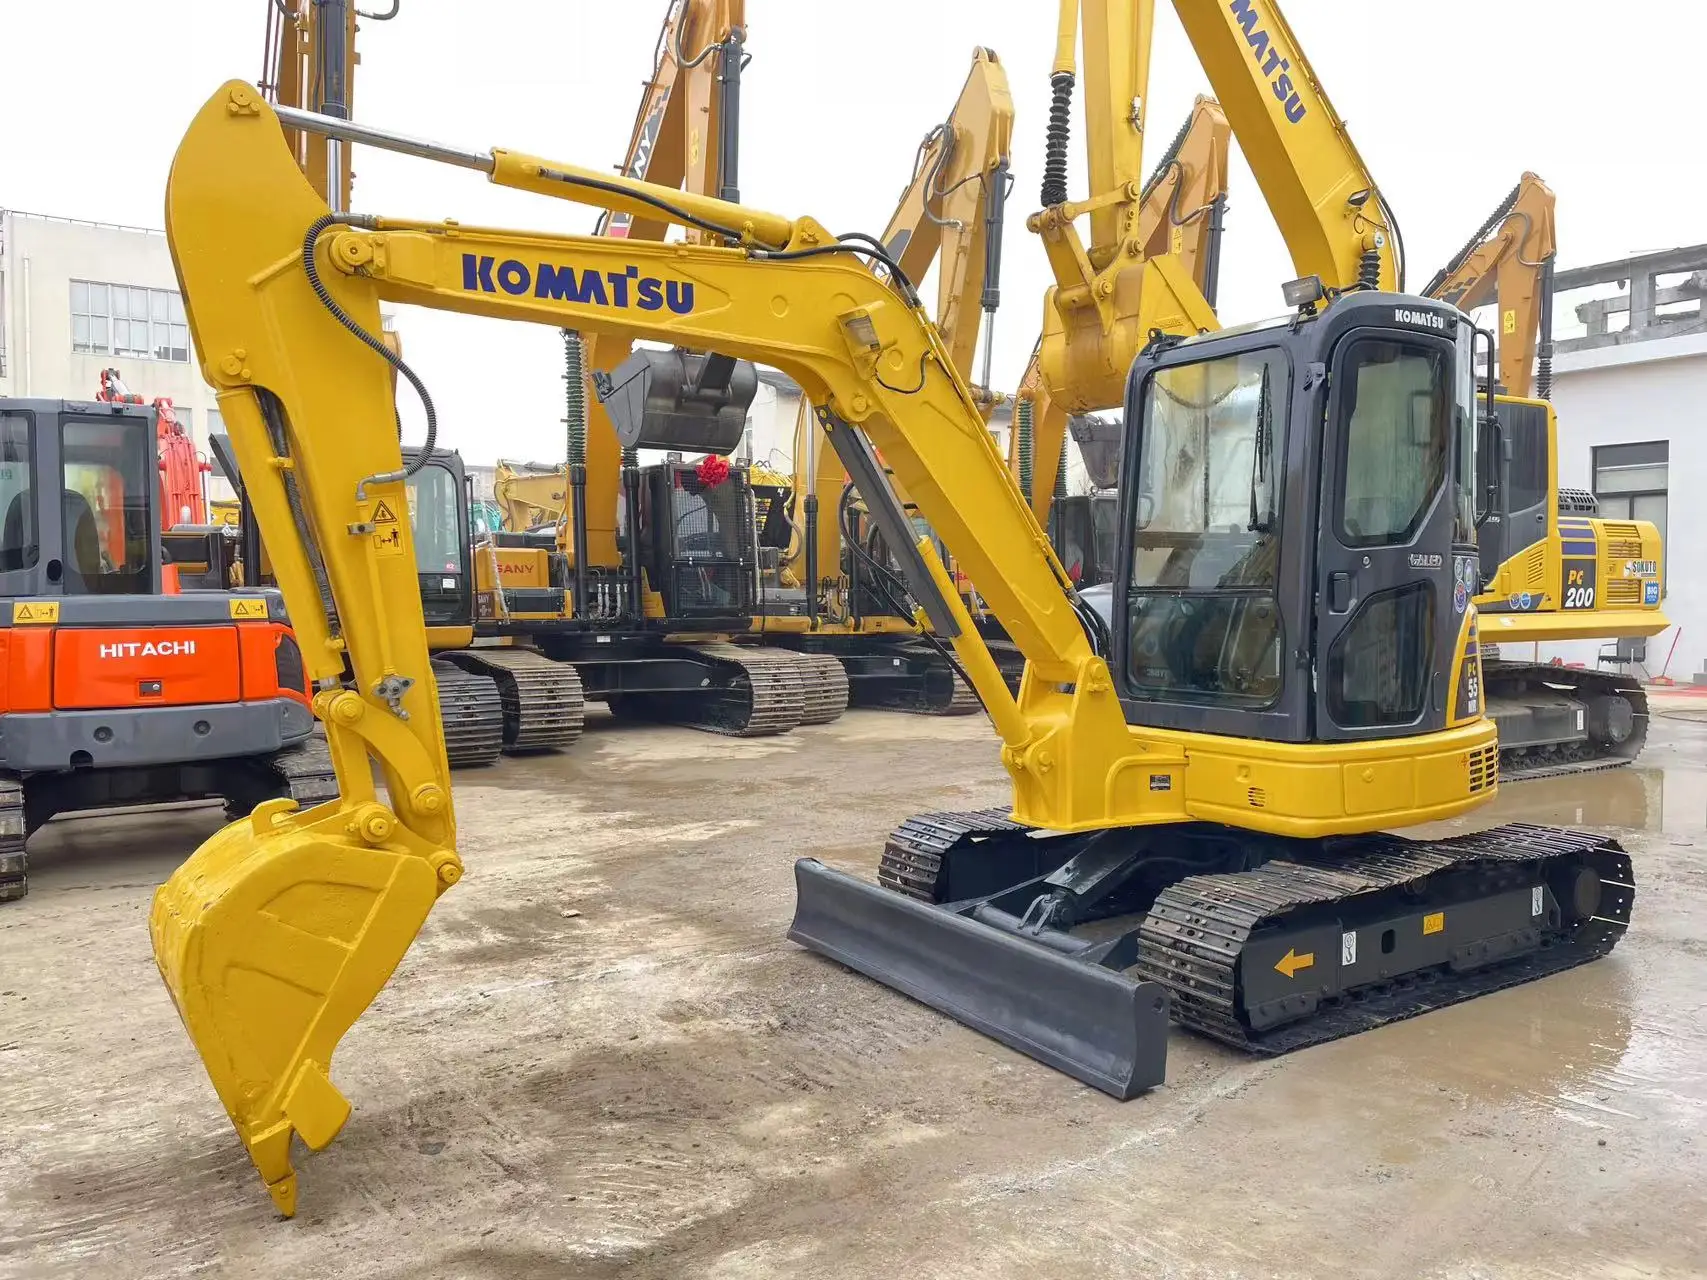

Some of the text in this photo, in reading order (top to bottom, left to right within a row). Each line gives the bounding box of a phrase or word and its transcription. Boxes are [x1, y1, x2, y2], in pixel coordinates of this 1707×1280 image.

[462, 253, 694, 314] KOMATSU
[1394, 308, 1444, 329] KOMATSU
[495, 563, 534, 574] SANY
[1632, 560, 1657, 573] SOKUTO
[1567, 569, 1584, 585] PC
[1564, 587, 1594, 608] 200
[100, 640, 195, 658] HITACHI
[1468, 678, 1478, 698] 55
